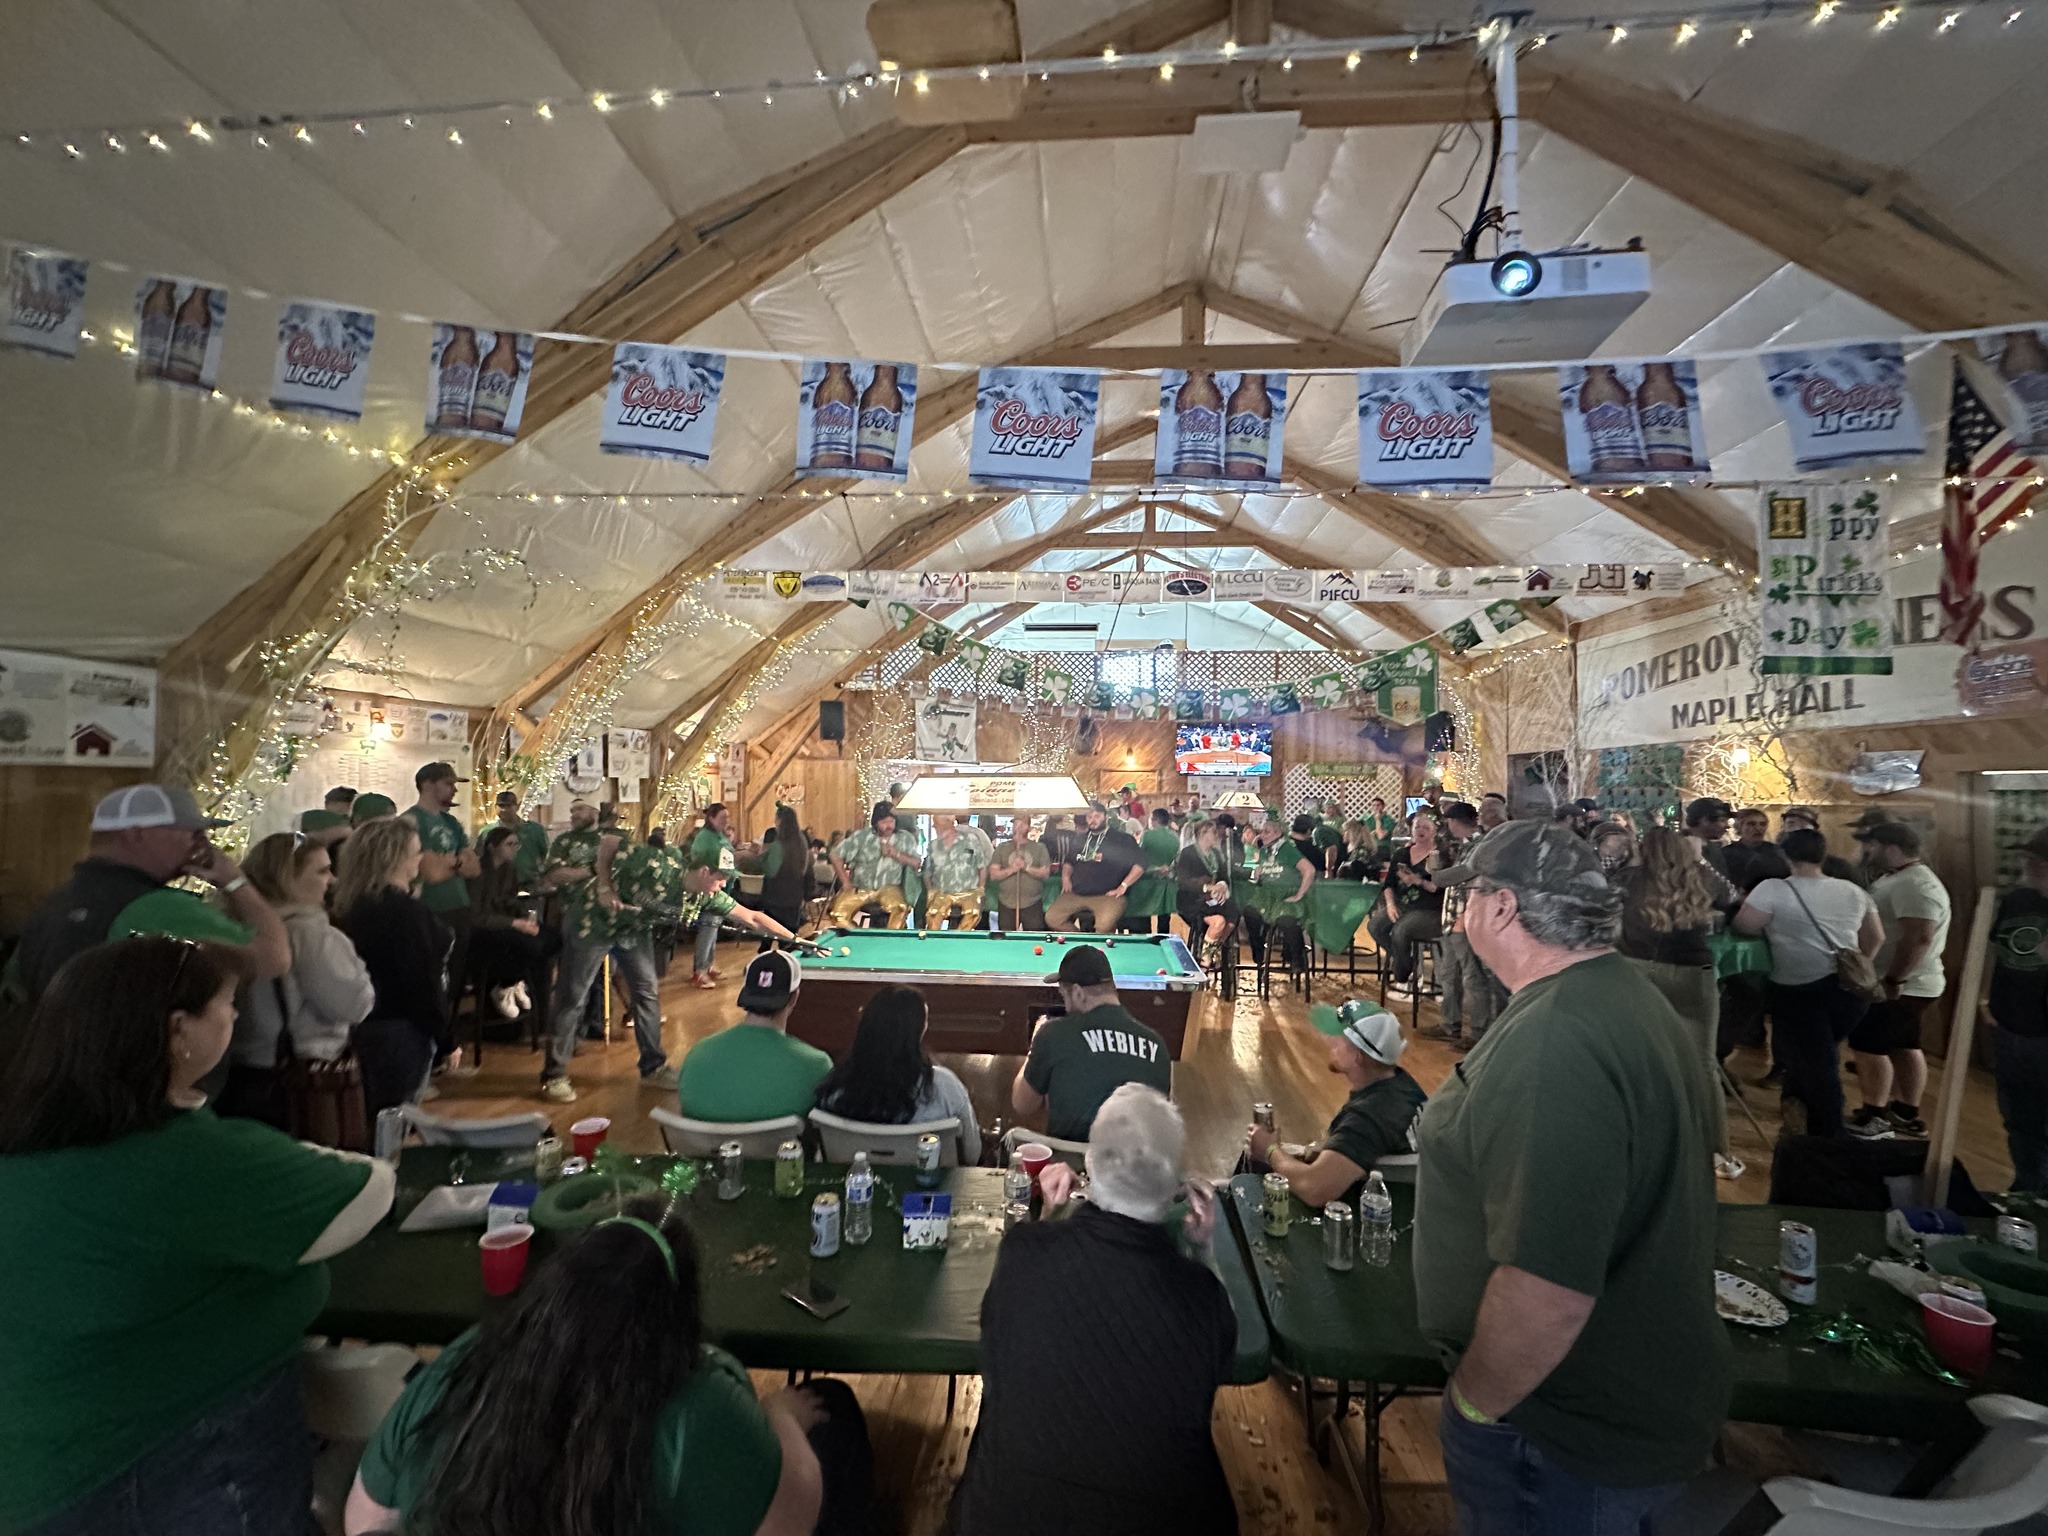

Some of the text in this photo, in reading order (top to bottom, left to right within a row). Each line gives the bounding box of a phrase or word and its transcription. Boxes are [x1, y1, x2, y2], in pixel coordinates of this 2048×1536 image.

[286, 330, 358, 373] Coors
[284, 363, 349, 389] LIGHT
[622, 371, 706, 414] Coors
[618, 406, 698, 432] LIGHT
[817, 425, 851, 436] LIGHT
[860, 411, 897, 433] Coors
[991, 398, 1082, 439] Coors
[1226, 416, 1269, 439] Coors
[1378, 401, 1478, 441] Coors
[1810, 408, 1902, 437] LIGHT
[989, 435, 1076, 459] LIGHT
[1181, 431, 1217, 443] LIGHT
[1379, 437, 1473, 461] LIGHT
[1227, 573, 1263, 584] LCCU
[1602, 629, 1744, 704] POMEROY
[1671, 677, 1867, 729] MAPLE HALL
[1082, 1029, 1159, 1063] WEBLEY
